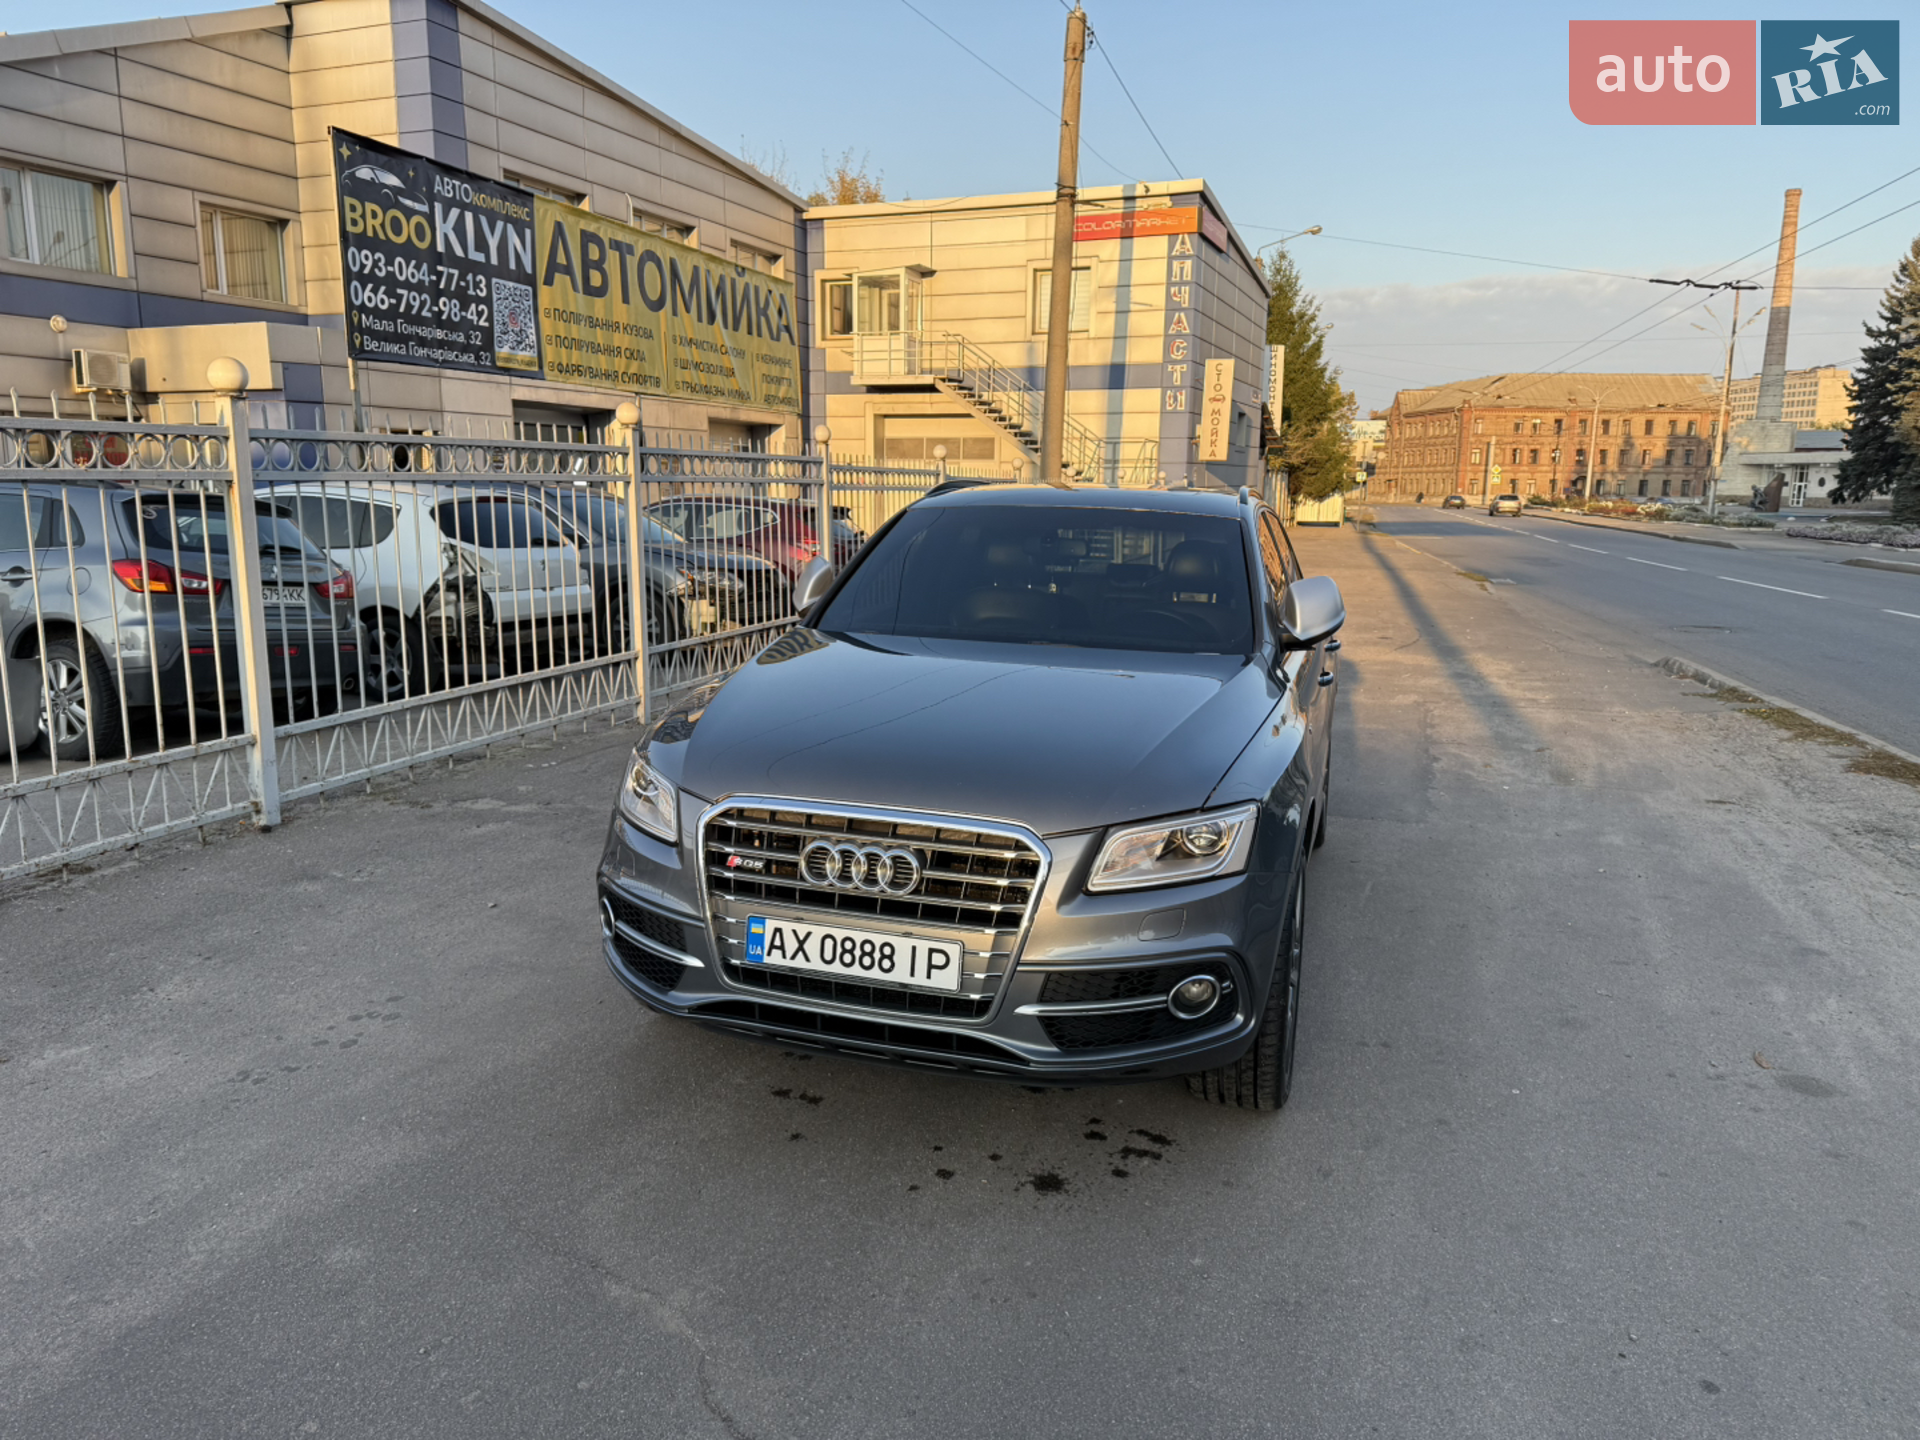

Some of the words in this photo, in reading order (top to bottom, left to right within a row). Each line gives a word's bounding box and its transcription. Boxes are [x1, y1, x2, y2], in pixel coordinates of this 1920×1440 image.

[348, 246, 488, 297] 093-064-77-13
[543, 219, 796, 346] АВТОМИЙКА
[350, 280, 490, 328] 066-792-98-42
[361, 313, 395, 332] Мала
[468, 330, 483, 345] 32
[553, 308, 621, 334] ПОЛІРУВАННЯ
[622, 321, 654, 341] КУЗОВА
[363, 335, 407, 355] Велика
[479, 351, 492, 366] 32
[555, 334, 622, 359] ПОЛІРУВАННЯ
[623, 347, 647, 362] СКЛА
[556, 362, 620, 383] ФАРБУВАННЯ
[621, 371, 662, 388] СУПОРТІВ
[1213, 362, 1224, 392] СТО
[1208, 407, 1222, 458] МОЙКА
[749, 944, 763, 956] UA
[766, 927, 813, 962] AX
[819, 933, 896, 973] 0888
[909, 945, 951, 980] IP
